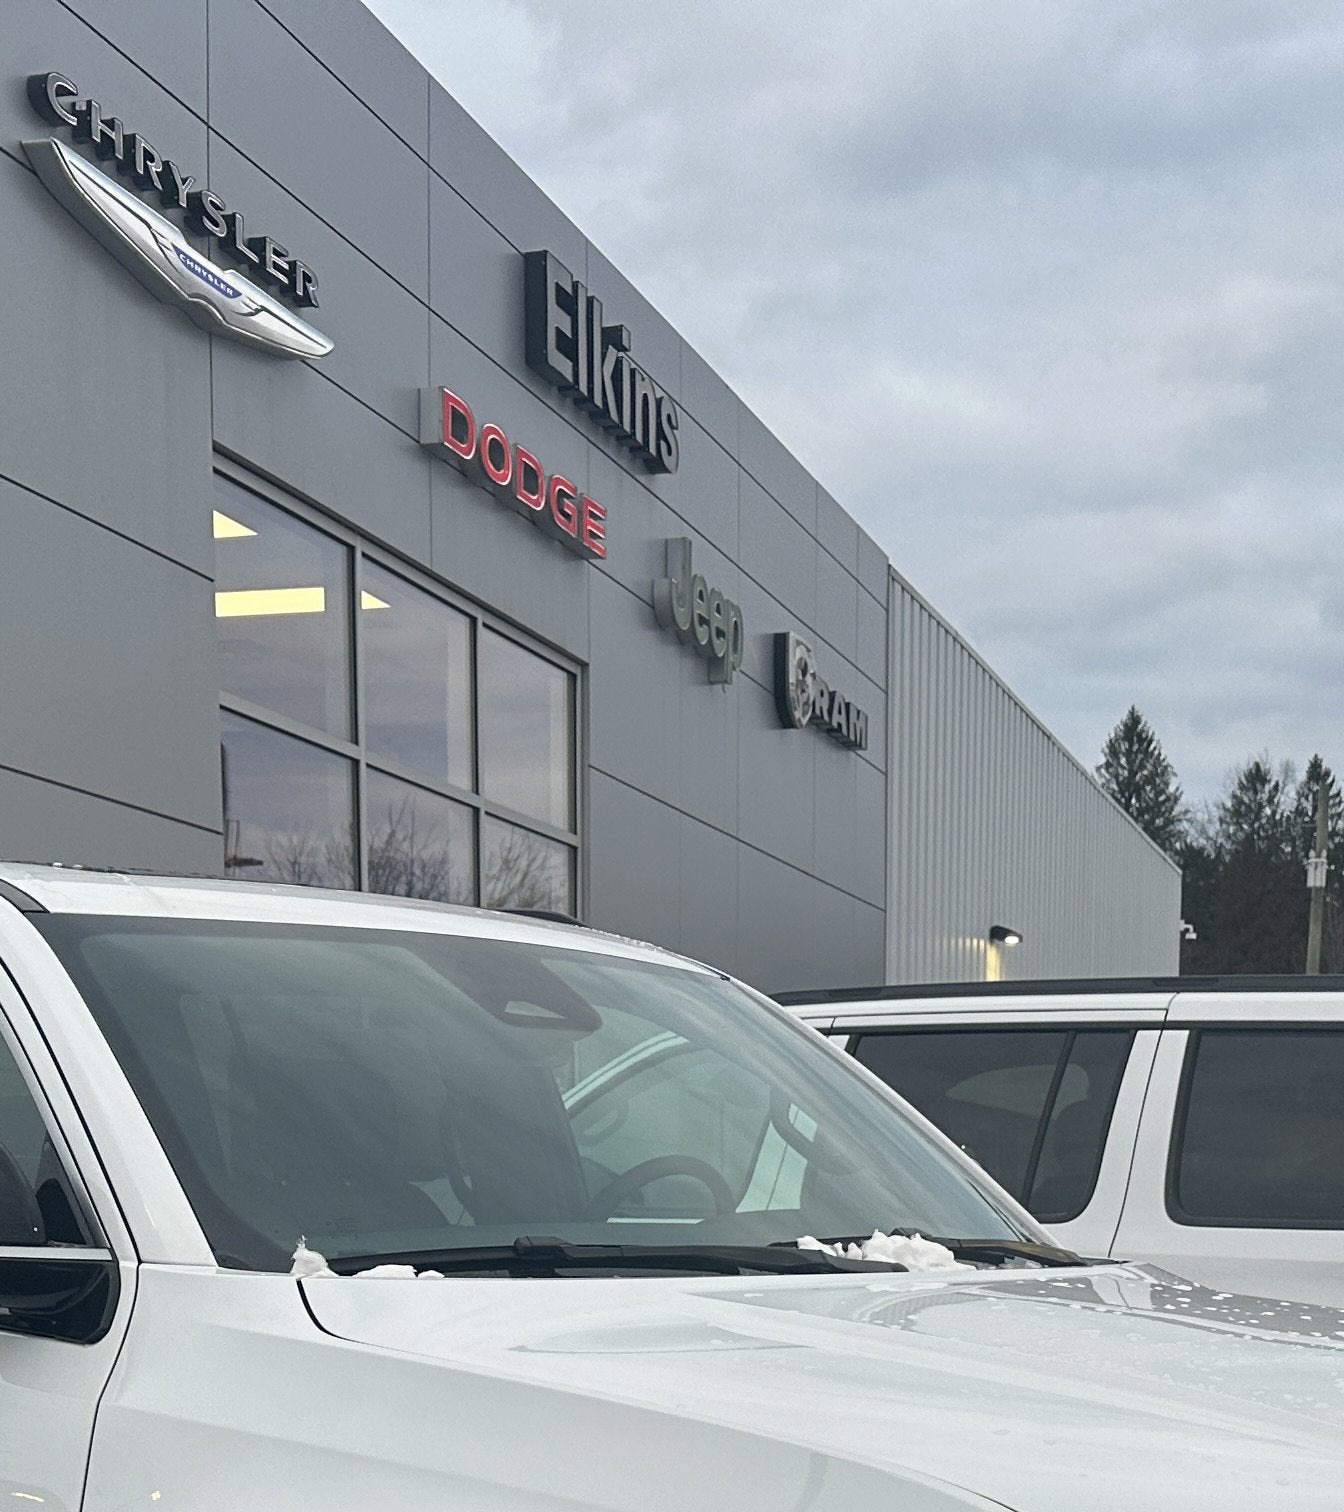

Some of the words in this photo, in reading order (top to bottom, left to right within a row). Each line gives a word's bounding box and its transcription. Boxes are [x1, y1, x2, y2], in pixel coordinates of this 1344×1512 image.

[30, 72, 319, 308] CHRYSLER
[179, 253, 234, 296] CHRYSLER
[528, 250, 679, 474] Elkins
[430, 386, 607, 559] DODGE
[654, 537, 744, 685] Jeep
[812, 673, 868, 751] RAM
